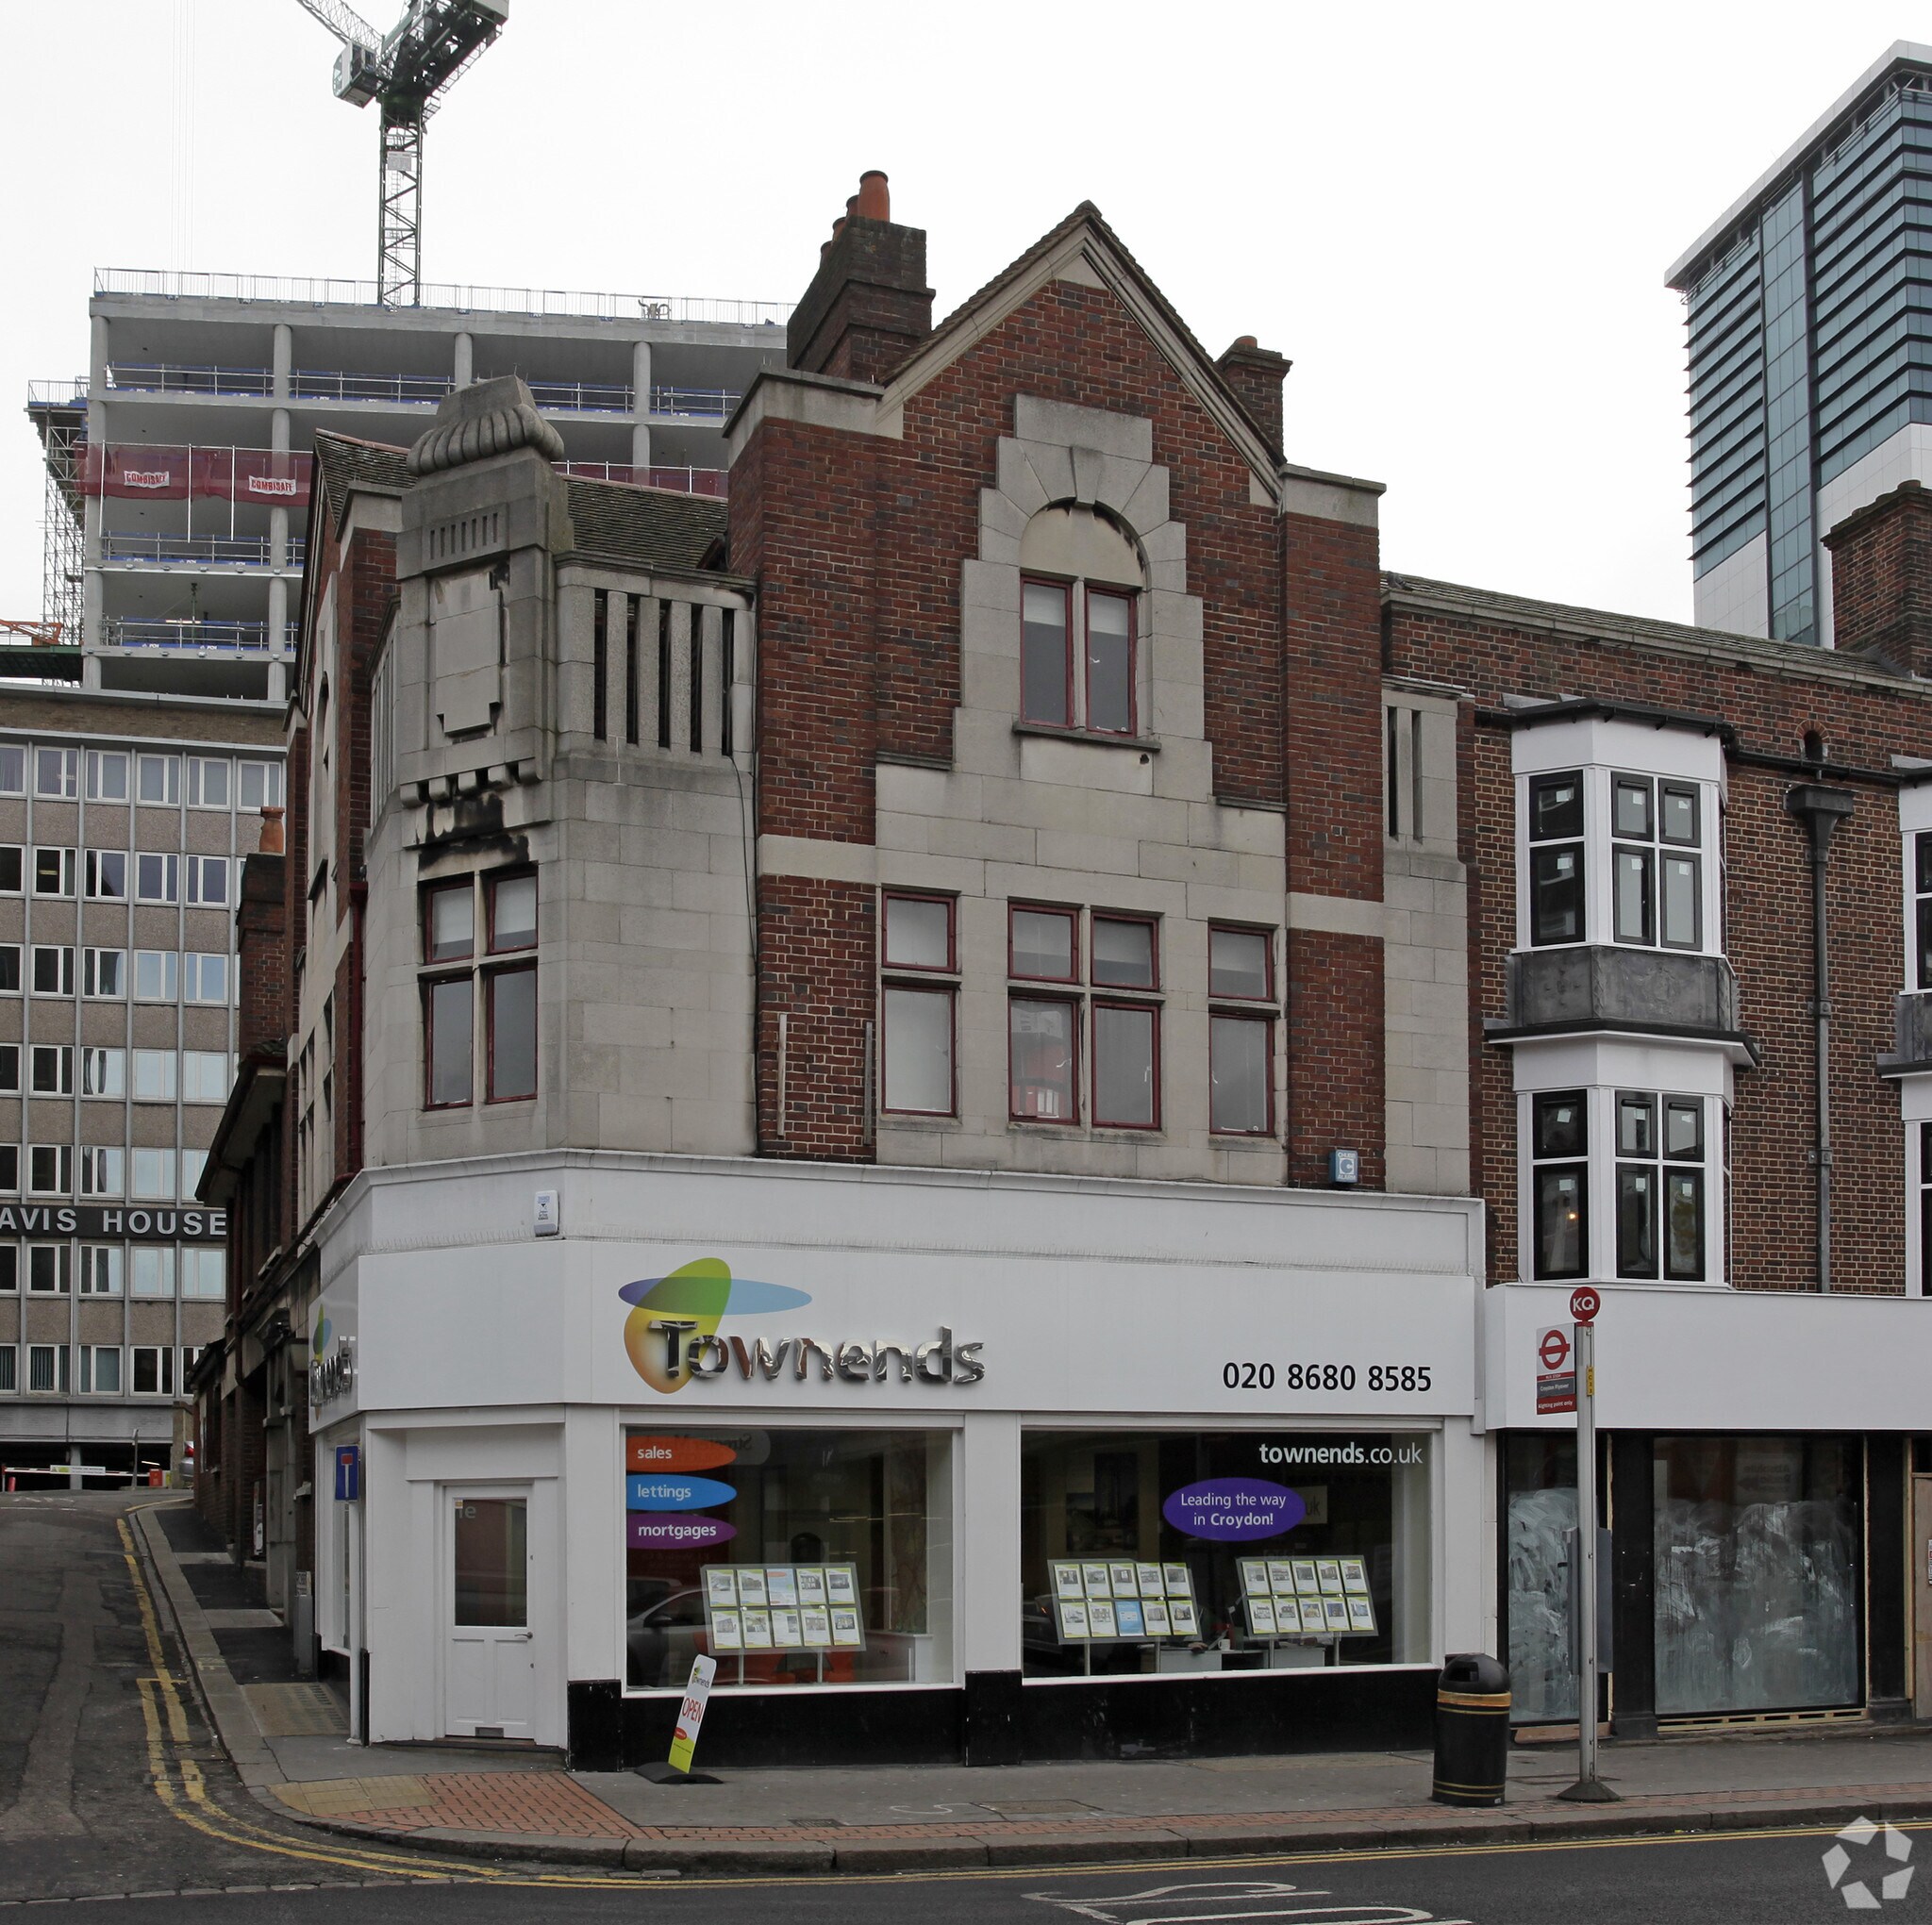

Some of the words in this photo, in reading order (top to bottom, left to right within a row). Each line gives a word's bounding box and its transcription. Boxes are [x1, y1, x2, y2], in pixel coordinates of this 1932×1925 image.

[126, 473, 167, 485] COMBISAFE
[251, 481, 294, 492] COMBISAFE
[0, 1207, 76, 1231] AVIS
[103, 1210, 226, 1236] HOUSE
[1573, 1296, 1594, 1312] KQ
[648, 1319, 985, 1385] Townends
[1224, 1362, 1274, 1389] 020
[1288, 1364, 1356, 1391] 8680
[1368, 1366, 1431, 1392] 8585
[637, 1446, 673, 1459] sales
[1259, 1442, 1423, 1464] townends.co.uk
[637, 1485, 691, 1502] lettings
[1181, 1493, 1231, 1509] Leading
[1236, 1493, 1257, 1506] the
[1260, 1496, 1286, 1509] way
[1193, 1513, 1206, 1525] in
[1210, 1513, 1274, 1529] Croydon!
[638, 1524, 717, 1539] mortgages
[682, 1698, 705, 1724] OPEN
